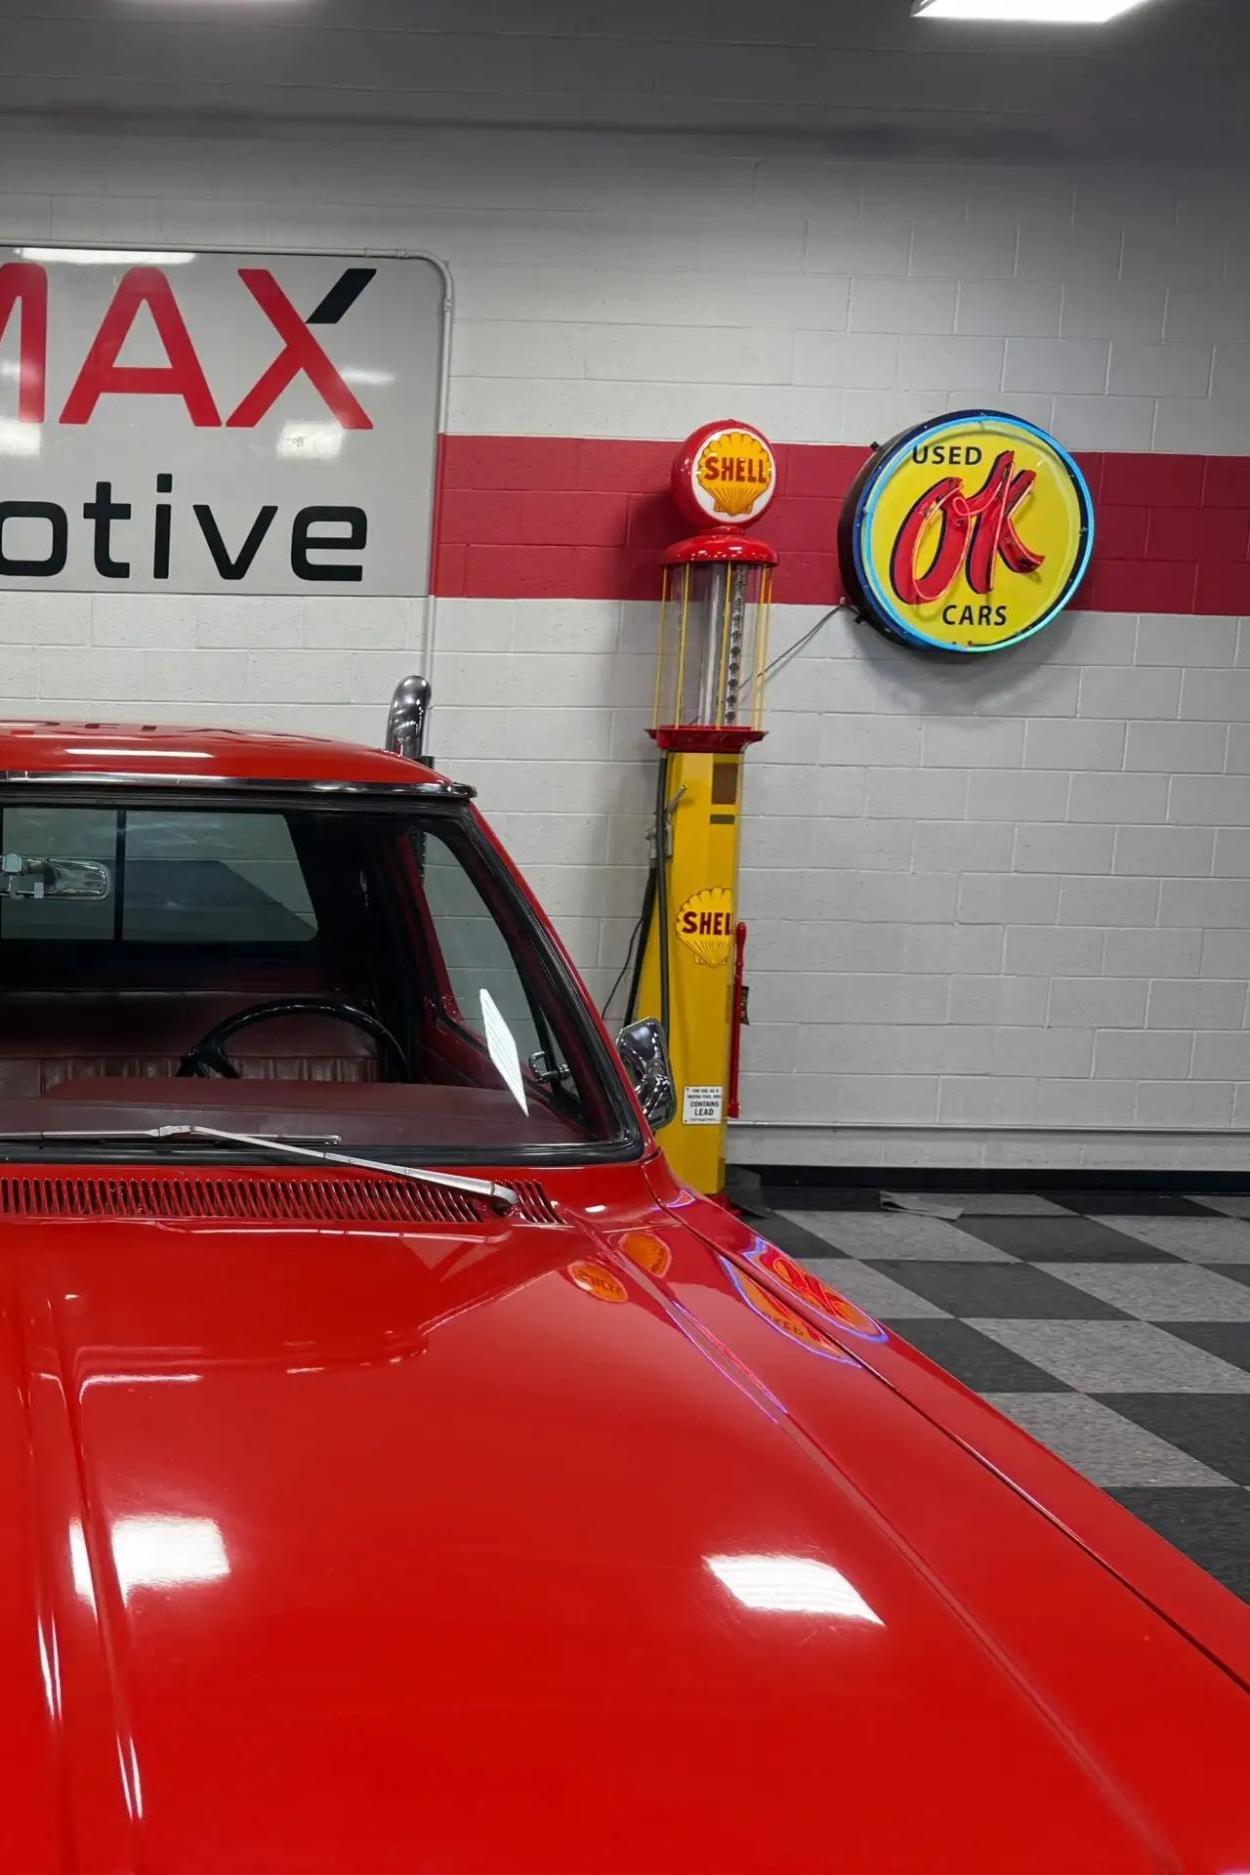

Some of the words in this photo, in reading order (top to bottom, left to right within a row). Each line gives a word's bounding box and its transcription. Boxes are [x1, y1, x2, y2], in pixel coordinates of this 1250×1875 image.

[912, 445, 983, 466] USED
[704, 456, 767, 484] SHELL
[889, 450, 1046, 605] OK
[942, 604, 1007, 626] CARS
[690, 1100, 719, 1108] CONTAINS
[694, 1108, 714, 1116] LEAD
